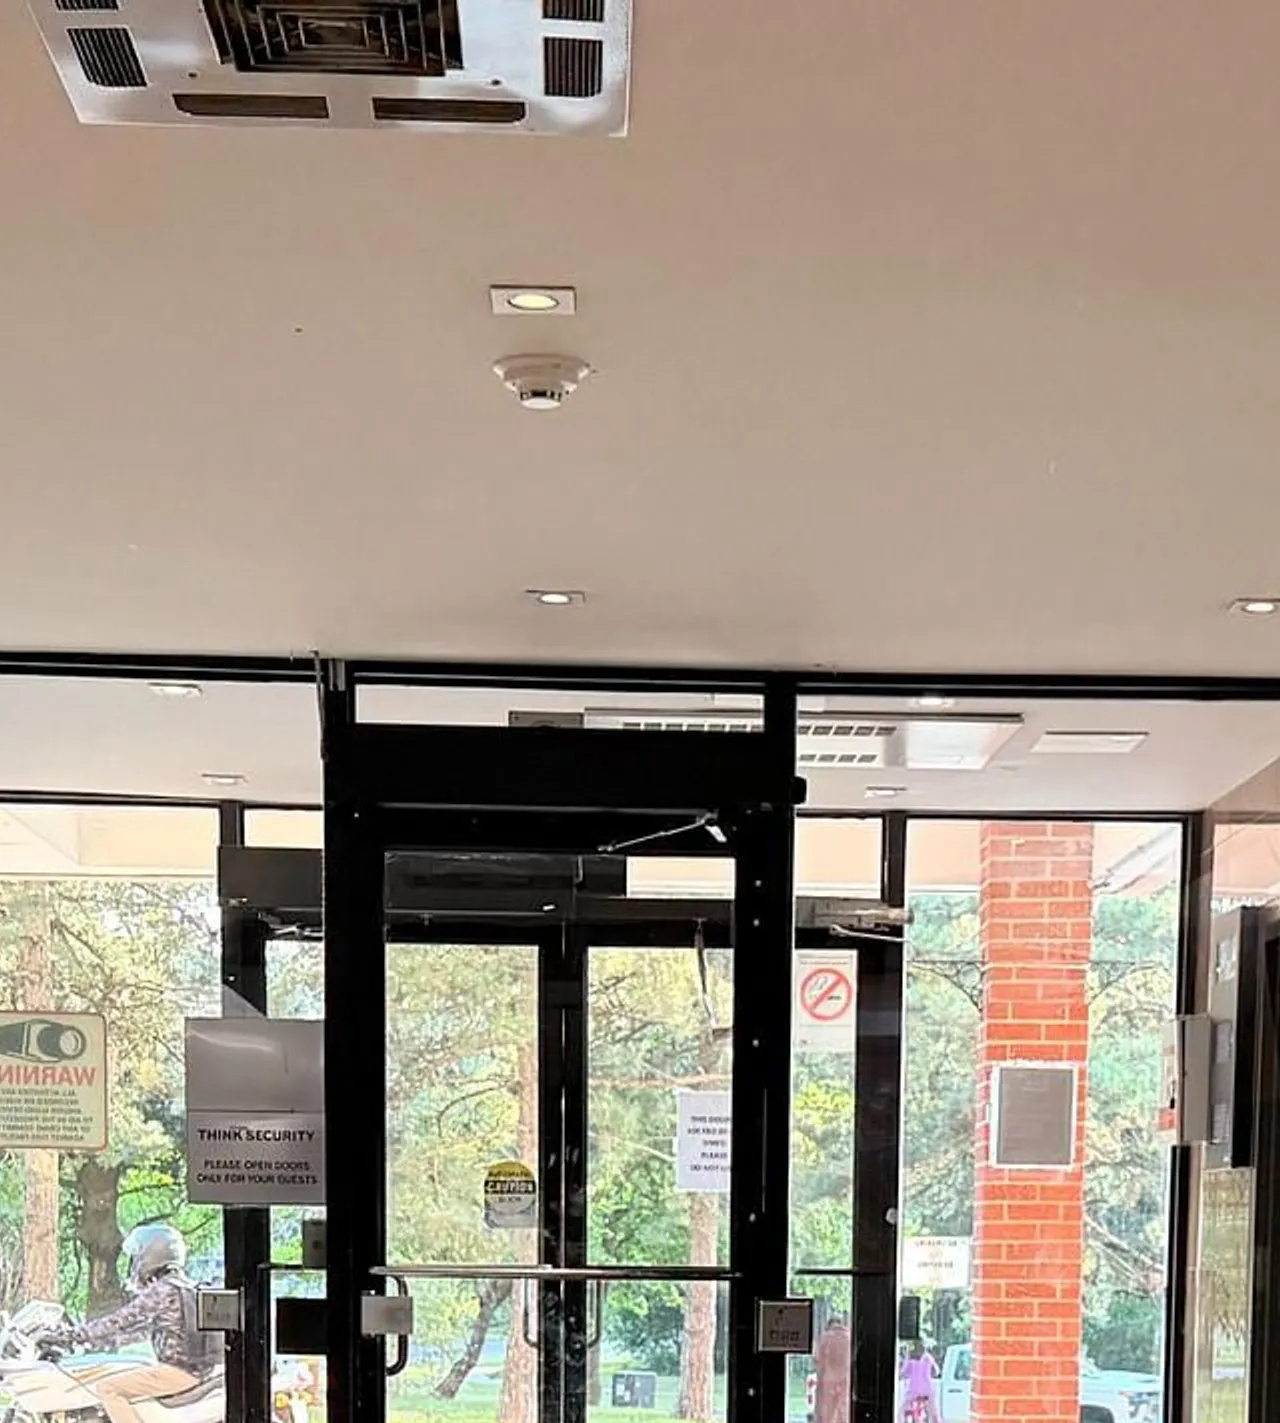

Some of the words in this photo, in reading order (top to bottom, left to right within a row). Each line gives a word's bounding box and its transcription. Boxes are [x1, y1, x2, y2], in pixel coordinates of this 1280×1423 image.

[197, 1129, 242, 1142] THINK
[245, 1129, 315, 1142] SECURITY
[204, 1160, 241, 1170] PLEASE
[244, 1160, 272, 1170] OPEN
[274, 1160, 310, 1171] DOORS
[196, 1173, 221, 1184] ONLY
[224, 1173, 245, 1184] FOR
[248, 1174, 275, 1184] YOUR
[277, 1174, 318, 1185] GUESTS
